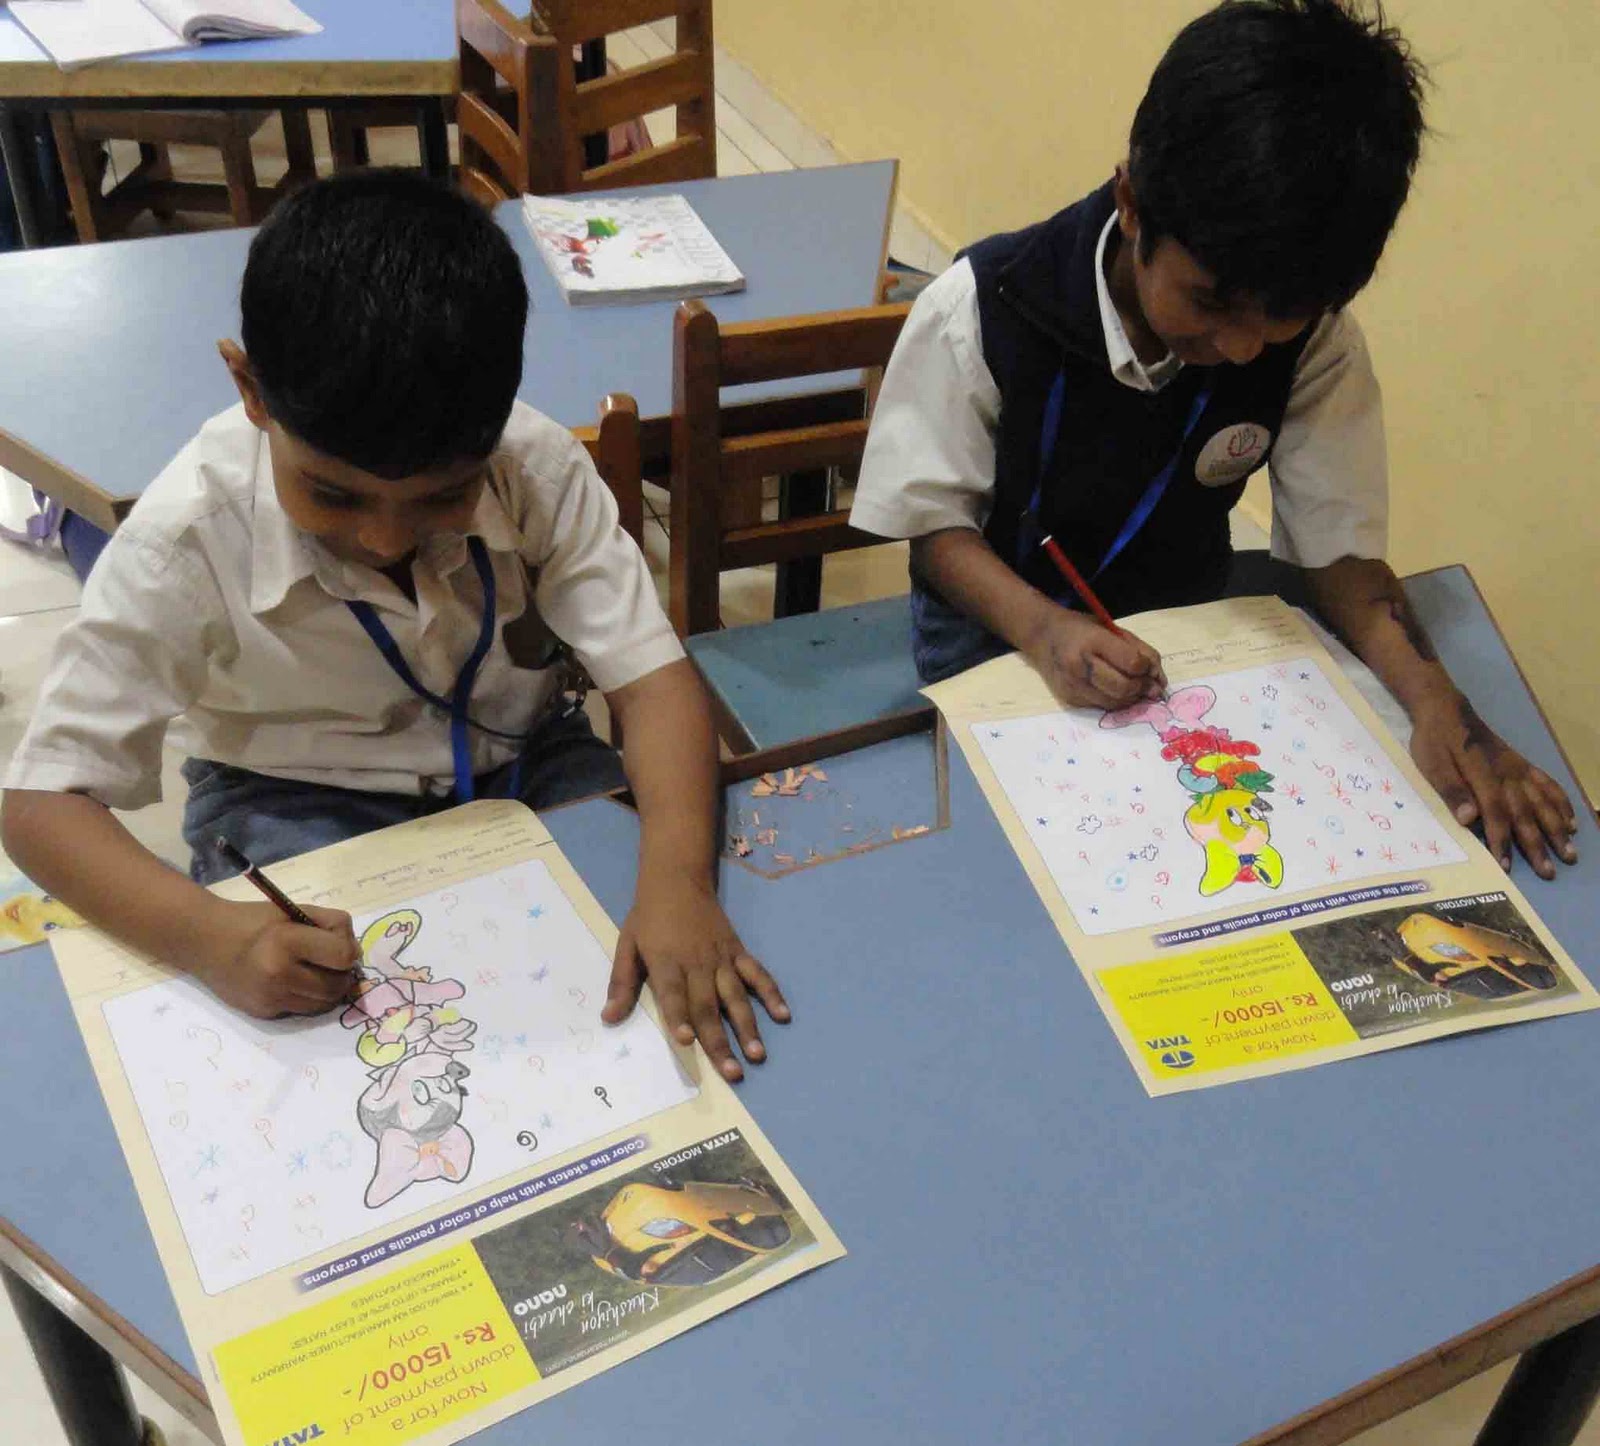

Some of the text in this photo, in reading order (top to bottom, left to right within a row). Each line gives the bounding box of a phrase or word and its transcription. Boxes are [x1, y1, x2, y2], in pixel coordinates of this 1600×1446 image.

[1156, 880, 1428, 945] Color the sketch with help of color pencils and crayons
[1433, 890, 1506, 912] TATA MOTORS
[1326, 972, 1377, 992] nano
[1195, 991, 1320, 1030] Rs. 15000/-
[1144, 1032, 1192, 1052] TATA
[650, 1129, 740, 1174] TATA MOTORS
[300, 1137, 646, 1288] Color the sketch with help of color pencils and crayons
[510, 1282, 570, 1318] nano
[515, 1289, 602, 1343] ki chaabi
[570, 1277, 667, 1341] Khushiyon
[382, 1319, 431, 1353] only
[337, 1320, 497, 1407] Rs. 15000/-
[337, 1340, 519, 1435] down payment of
[389, 1378, 489, 1433] Now for a
